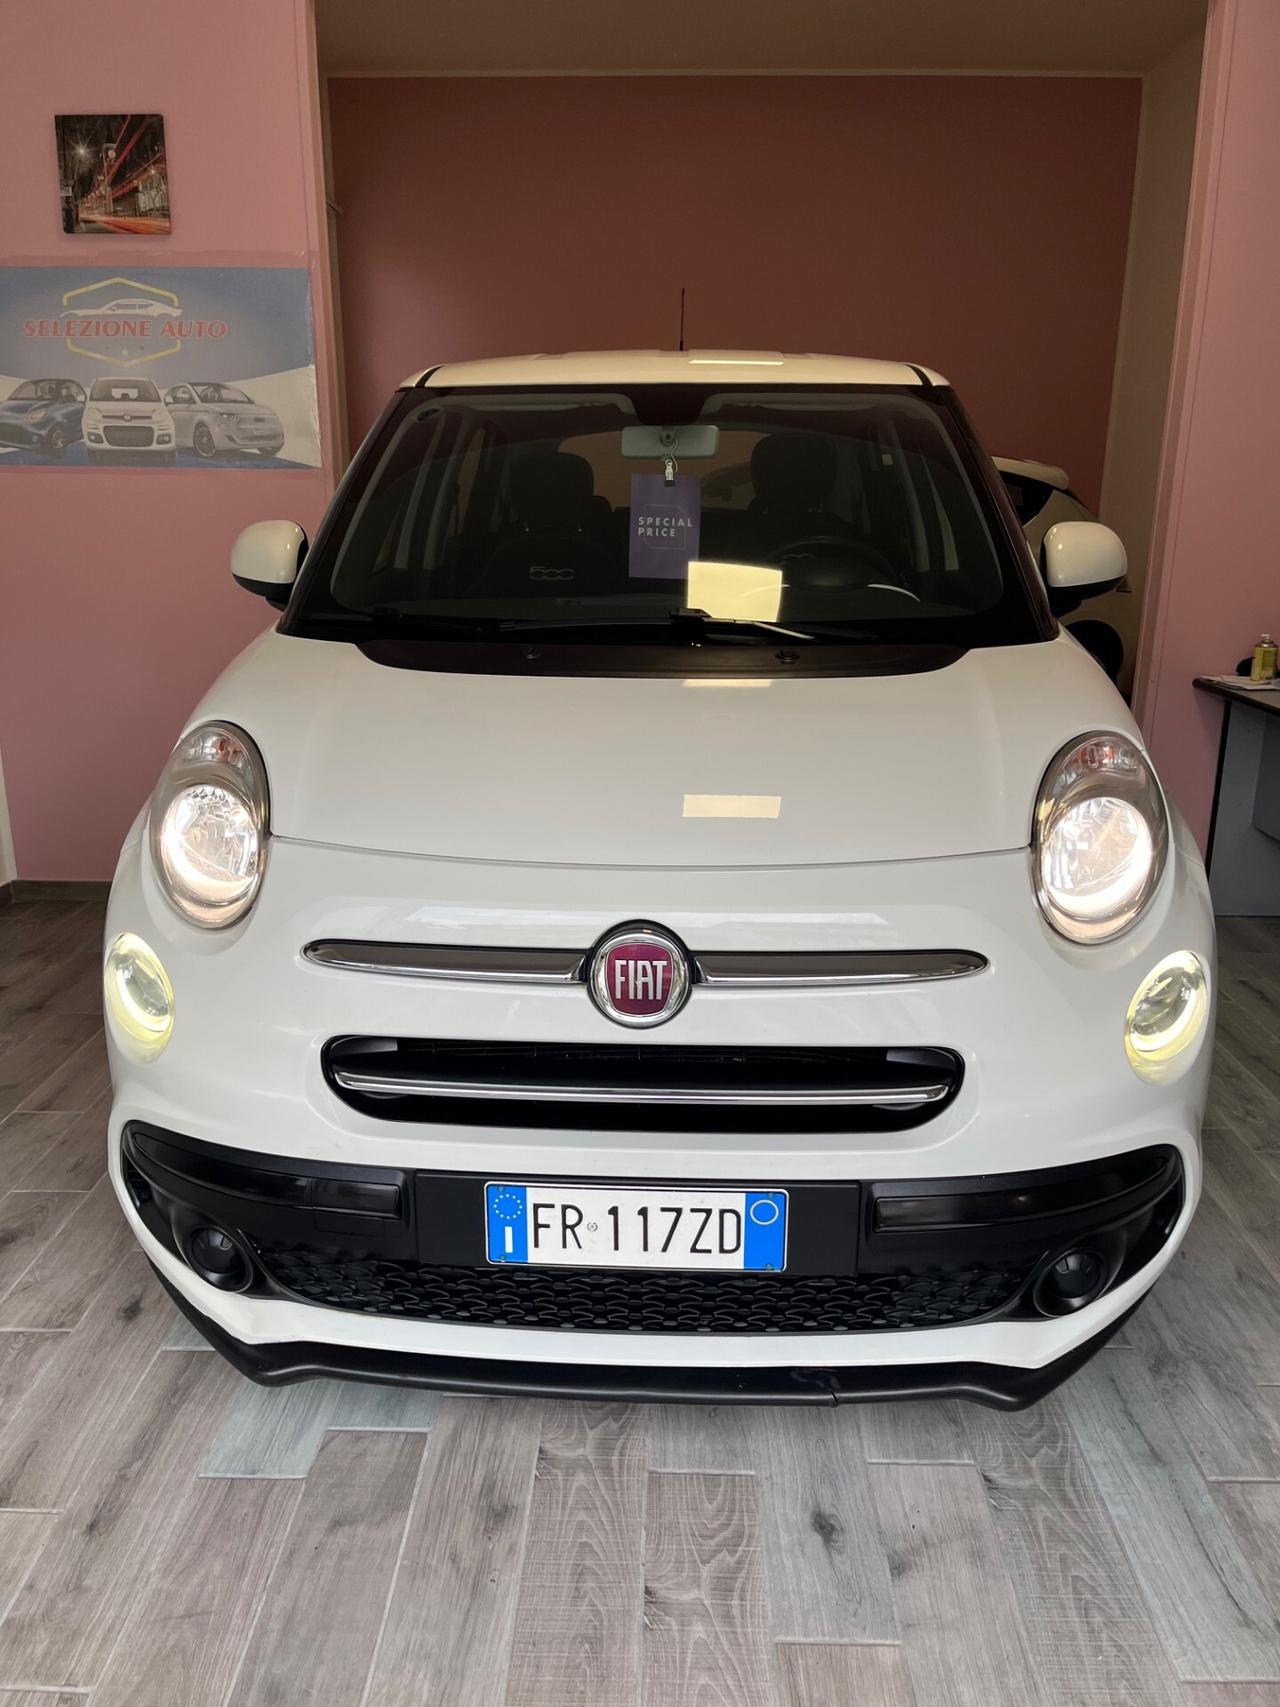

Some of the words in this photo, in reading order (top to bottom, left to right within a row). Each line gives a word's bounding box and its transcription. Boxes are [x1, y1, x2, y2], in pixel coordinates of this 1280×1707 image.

[23, 319, 152, 337] SELEZIONE
[160, 319, 228, 338] AUTO
[637, 516, 693, 527] SPECIAL
[637, 527, 676, 537] PRICE
[614, 959, 668, 1000] FIAT
